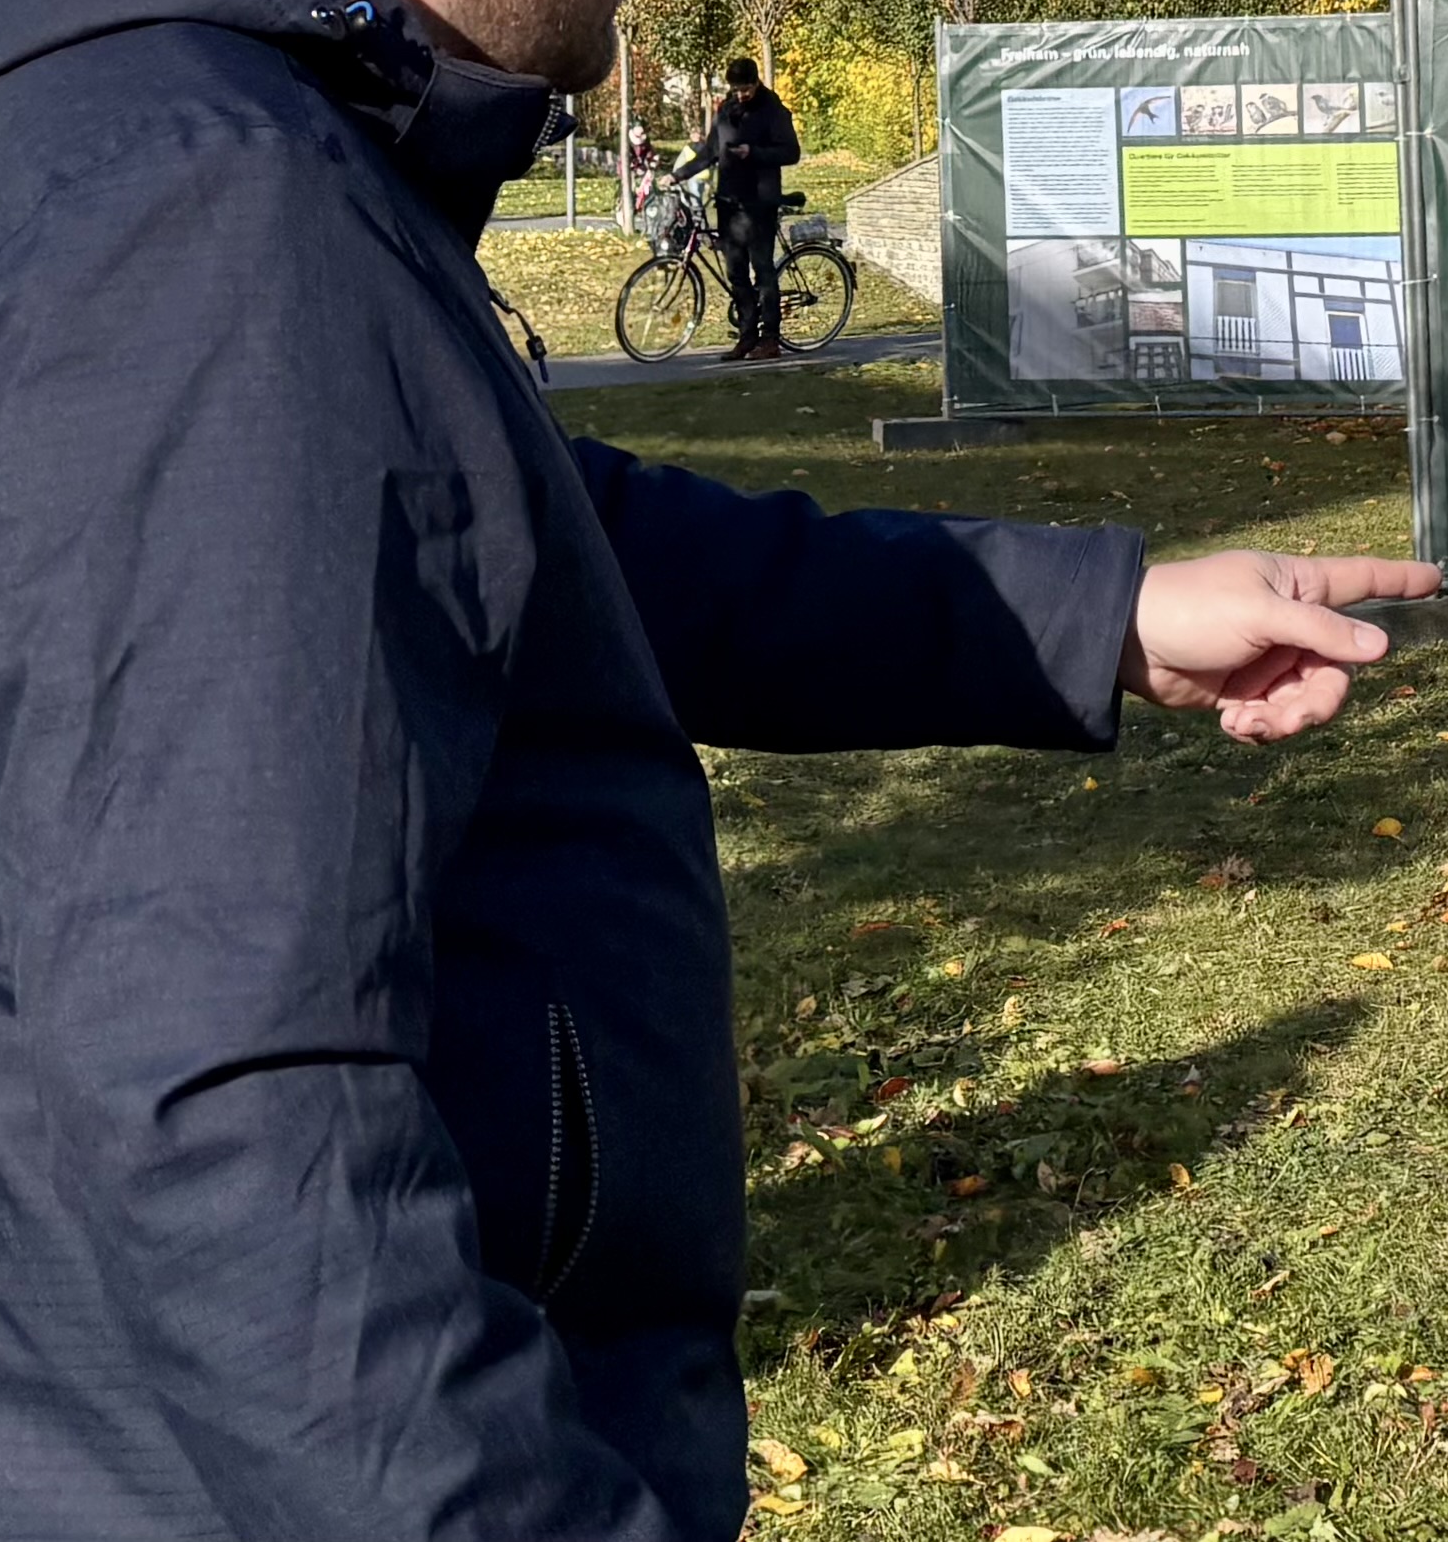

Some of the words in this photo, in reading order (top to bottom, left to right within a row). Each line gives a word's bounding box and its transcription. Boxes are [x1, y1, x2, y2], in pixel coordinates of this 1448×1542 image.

[1000, 46, 1059, 62] Freiham
[1073, 44, 1111, 62] grün,
[1113, 44, 1181, 61] lebendig,
[1184, 42, 1250, 58] naturnah
